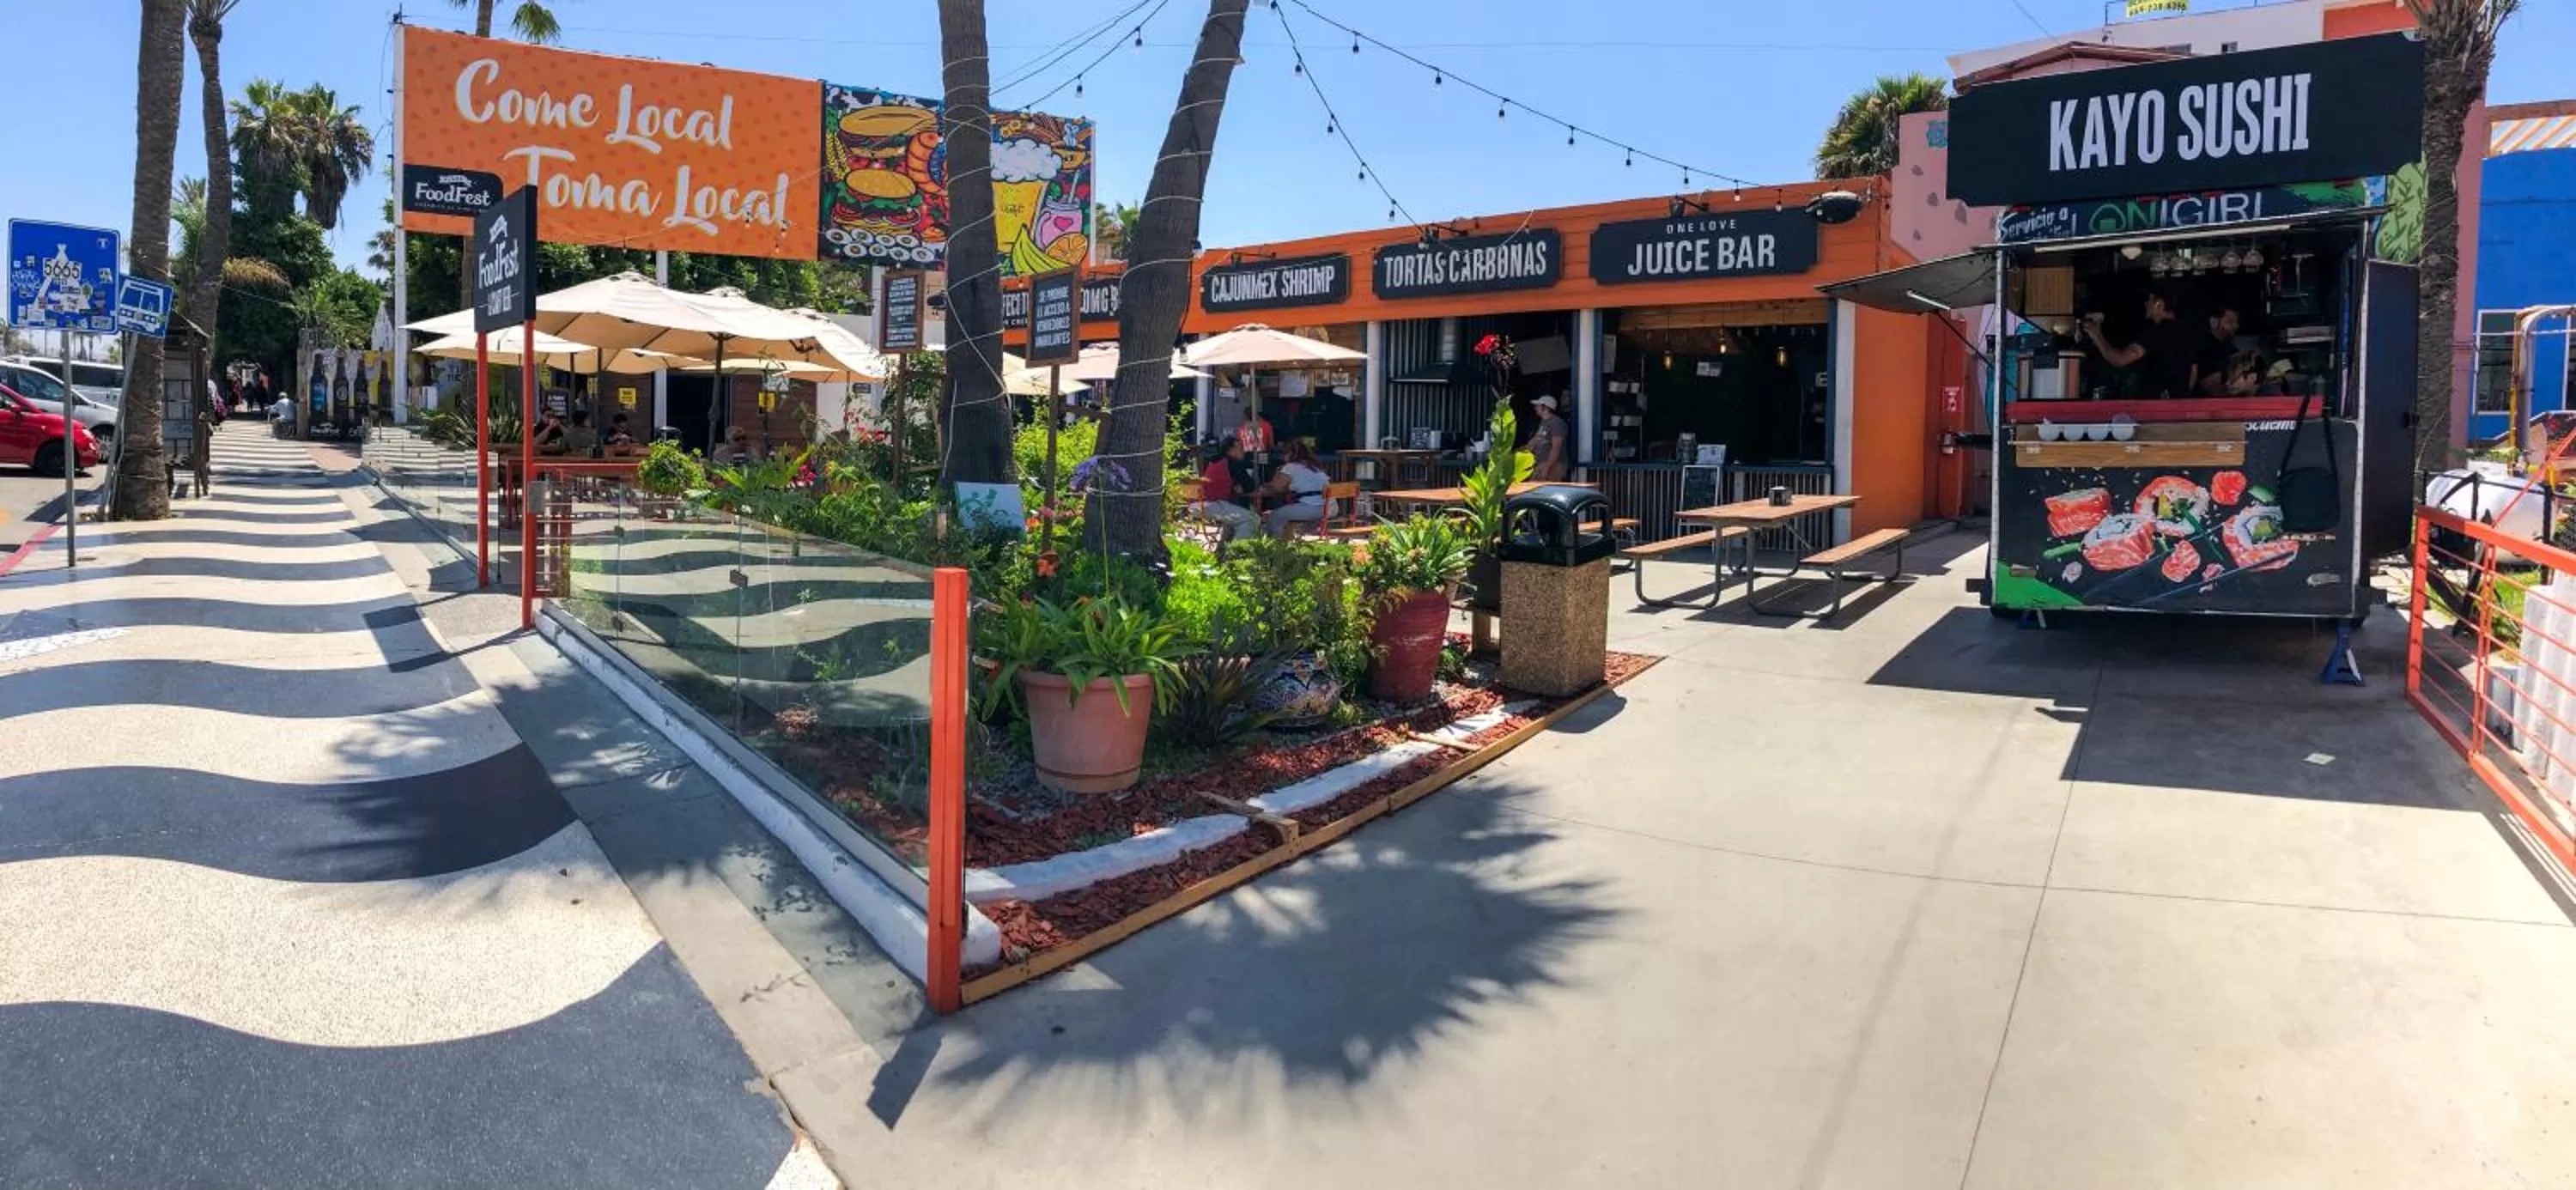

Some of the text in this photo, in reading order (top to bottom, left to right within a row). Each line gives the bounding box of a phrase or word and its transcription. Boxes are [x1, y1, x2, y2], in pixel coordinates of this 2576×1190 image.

[455, 58, 733, 155] Come Local
[2049, 73, 2312, 171] KAYO SUSHI
[416, 182, 491, 206] FoodFest
[501, 145, 790, 236] Toma Local
[1666, 219, 1737, 234] ONE LOVE
[44, 258, 80, 279] 5665
[478, 238, 519, 289] FoodFest
[1384, 240, 1546, 288] TORTAS CARBONAS
[1627, 234, 1776, 276] JUICE BAR
[1211, 265, 1335, 303] CAJUNMEX SHRIMP
